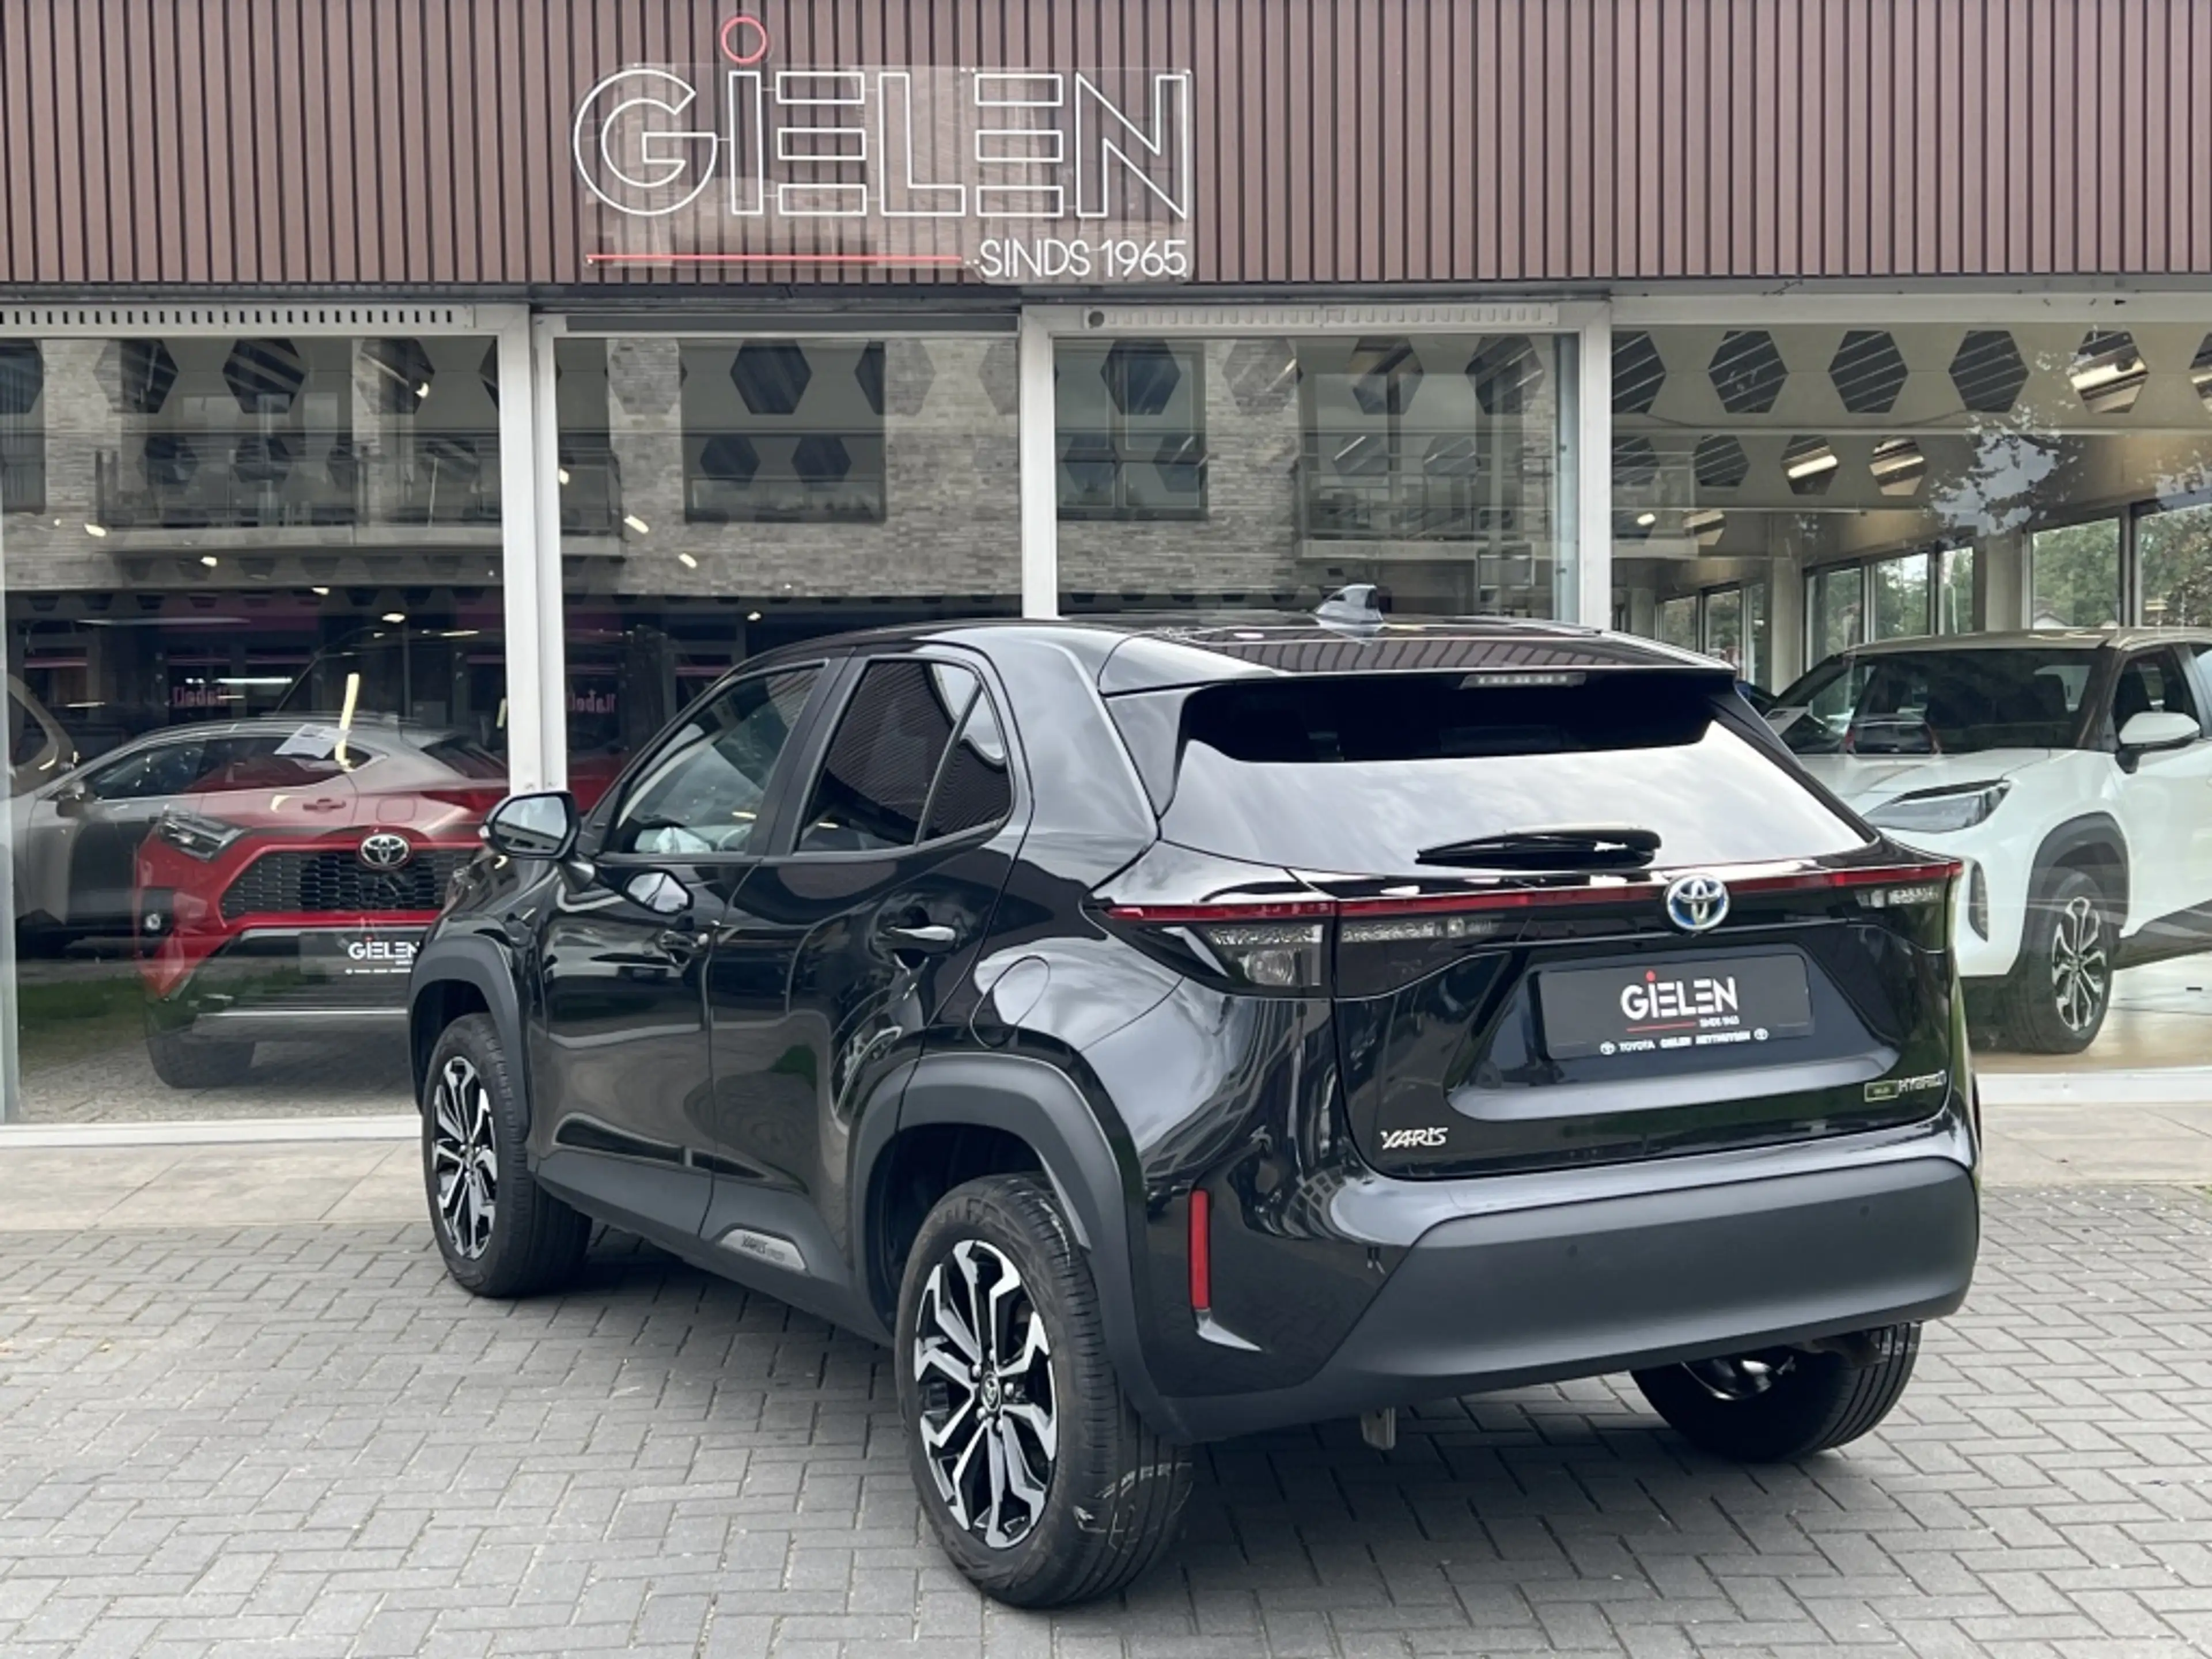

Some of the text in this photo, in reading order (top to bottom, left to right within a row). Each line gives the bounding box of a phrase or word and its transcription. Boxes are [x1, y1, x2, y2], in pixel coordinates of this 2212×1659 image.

[574, 13, 1189, 220] GIELEN
[980, 237, 1188, 278] SINDS 1965
[1620, 969, 1738, 1021] GIELEN
[1619, 1040, 1656, 1052] TOYOTA
[1380, 1127, 1449, 1150] YARIS
